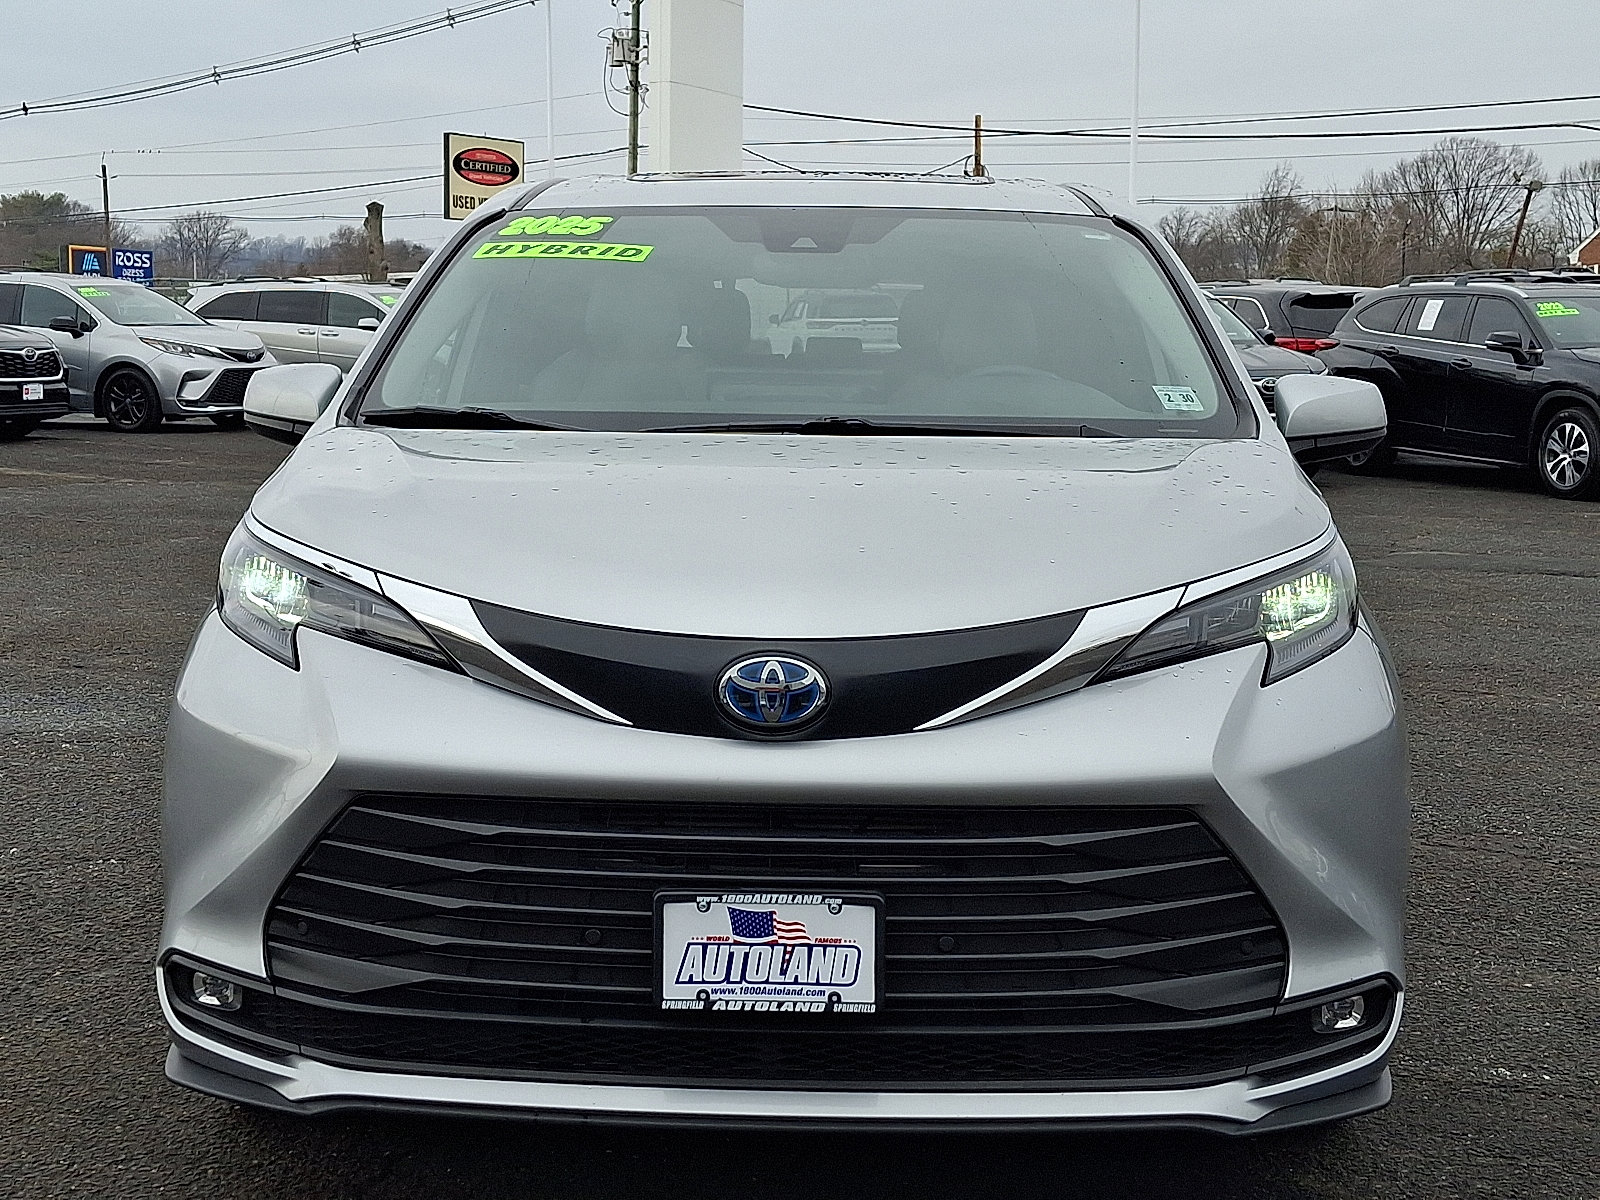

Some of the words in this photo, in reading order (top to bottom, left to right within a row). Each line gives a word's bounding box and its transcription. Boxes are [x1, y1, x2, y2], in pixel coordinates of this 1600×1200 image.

[461, 159, 511, 173] CERTIFIED
[453, 194, 476, 210] USED
[498, 215, 613, 236] 2025
[482, 243, 643, 258] HYBRID
[115, 251, 151, 268] ROSS
[1164, 393, 1175, 403] 2
[1179, 393, 1195, 403] 30
[696, 894, 842, 905] www.1800AUTOLAND.com
[678, 945, 860, 985] AUTOLAND
[710, 986, 826, 998] www.1800Autoland.com
[662, 1000, 704, 1010] SPRINGFIELD
[712, 1000, 826, 1012] AUTOLAND
[833, 1003, 876, 1013] SPRINGFIELD
